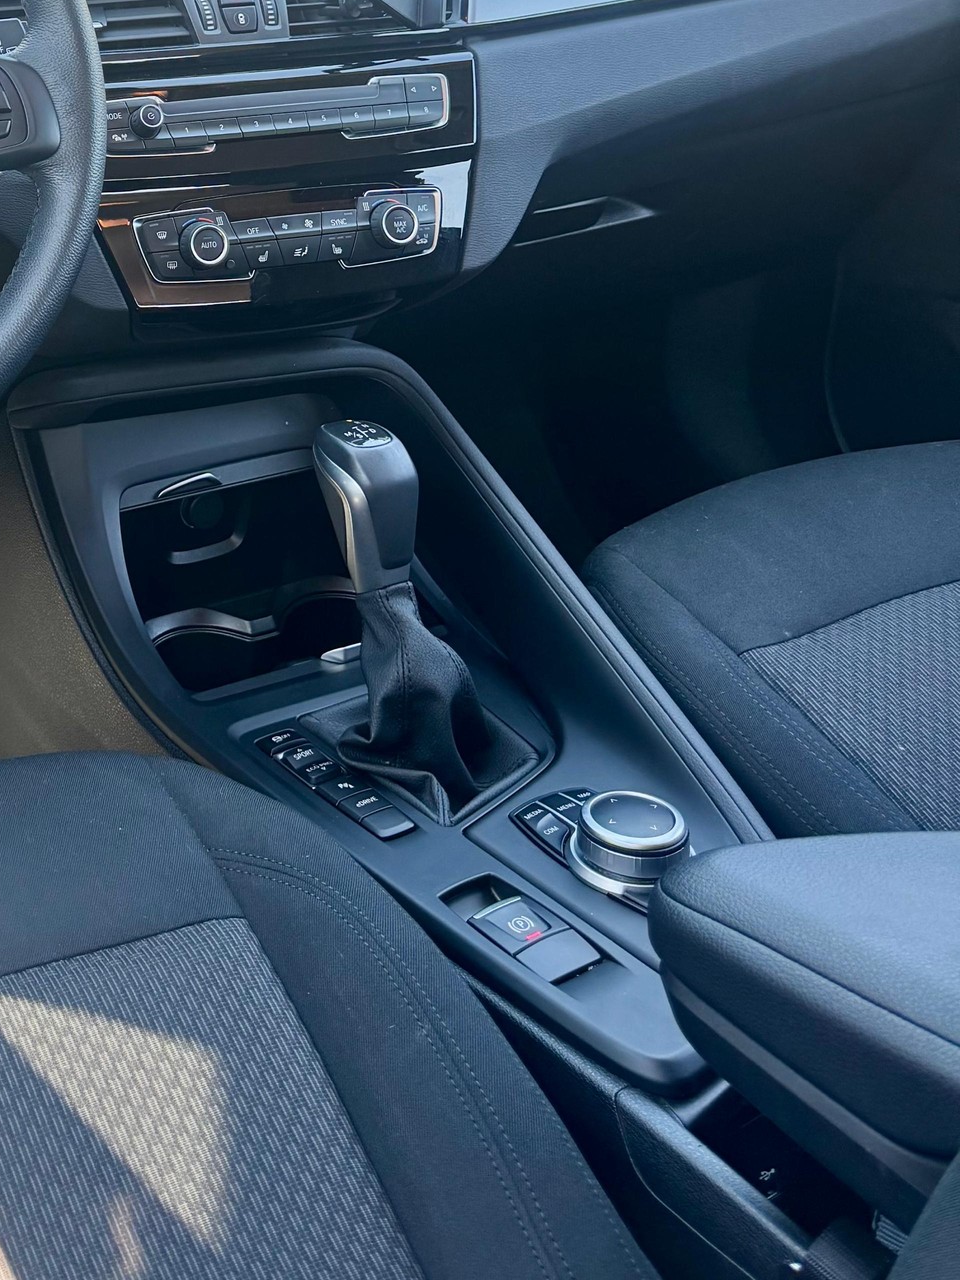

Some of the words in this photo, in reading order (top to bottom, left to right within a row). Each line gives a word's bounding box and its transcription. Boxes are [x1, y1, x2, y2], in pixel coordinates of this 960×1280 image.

[253, 120, 259, 128] 3
[287, 117, 293, 125] 4
[321, 114, 327, 122] 5
[353, 111, 360, 119] 6
[423, 106, 429, 114] 8
[417, 204, 429, 212] A/C
[393, 220, 407, 228] MAX
[247, 227, 260, 235] OFF
[200, 241, 218, 249] AUTO
[293, 749, 314, 760] SPORT
[356, 796, 379, 808] eDRIVE
[524, 808, 544, 820] MEDIA
[543, 825, 560, 835] COM
